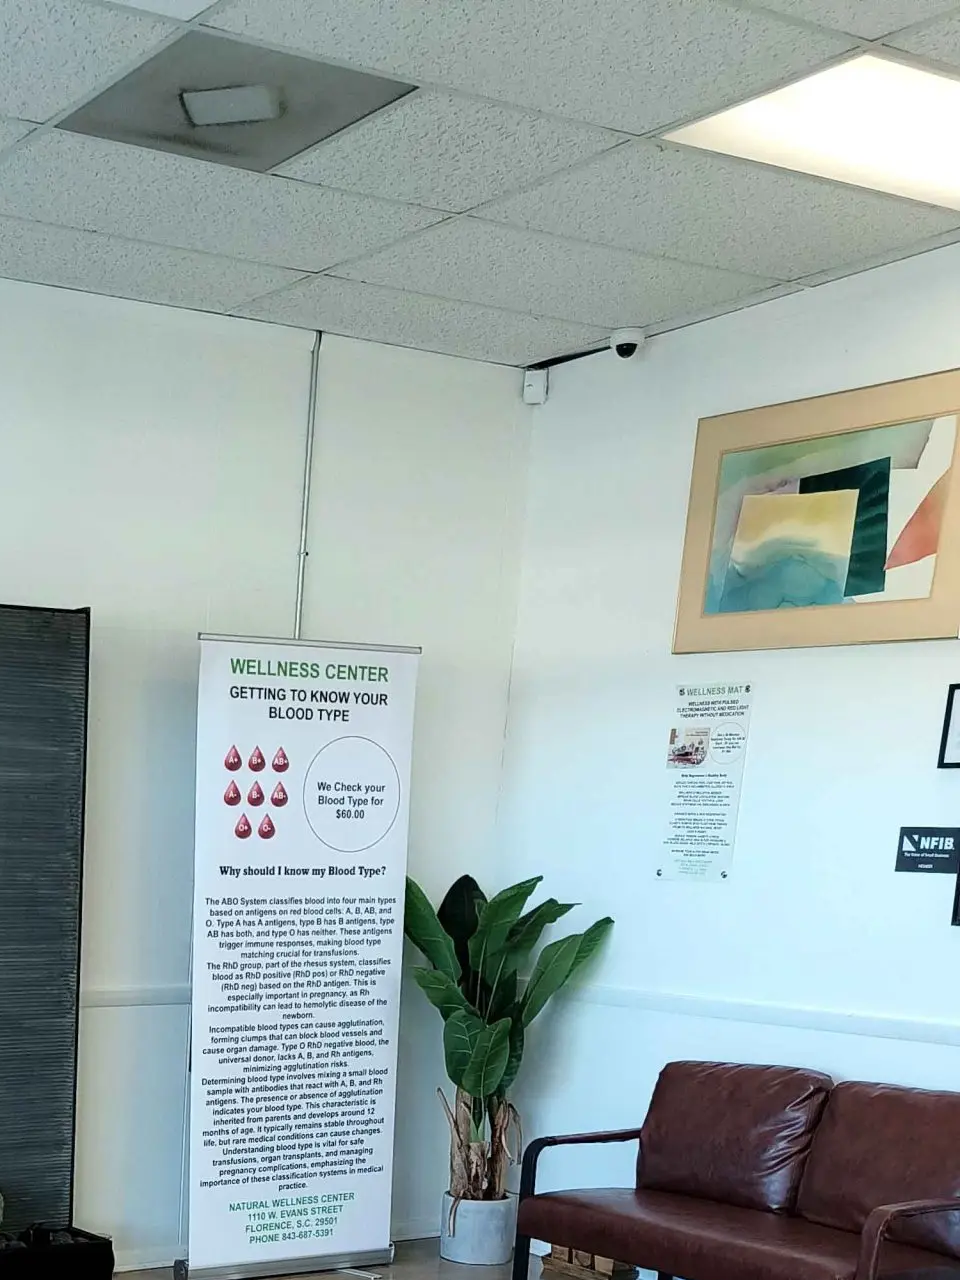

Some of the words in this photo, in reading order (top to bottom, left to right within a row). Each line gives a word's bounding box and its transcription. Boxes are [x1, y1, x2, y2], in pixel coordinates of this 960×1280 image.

[230, 658, 319, 679] WELLNESS
[325, 663, 388, 682] CENTER
[230, 686, 286, 701] GETTING
[291, 689, 306, 702] TO
[310, 690, 350, 704] KNOW
[353, 692, 387, 706] YOUR
[687, 687, 726, 696] WELLNESS
[728, 686, 744, 695] MAT
[269, 707, 313, 720] BLOOD
[319, 709, 349, 722] TYPE
[229, 756, 237, 764] A+
[317, 781, 331, 792] We
[333, 781, 362, 792] Check
[364, 783, 384, 795] your
[317, 794, 345, 805] Blood
[348, 794, 368, 809] Type
[370, 795, 383, 806] for
[336, 808, 364, 818] $60.00
[920, 837, 954, 850] NFIB
[219, 865, 240, 878] Why
[243, 865, 275, 875] should
[277, 865, 281, 875] I
[284, 865, 309, 875] know
[311, 867, 325, 878] my
[328, 865, 355, 875] Blood
[358, 865, 385, 878] Type?
[221, 897, 238, 905] ABO
[240, 897, 267, 906] System
[377, 896, 396, 905] types
[218, 940, 243, 949] trigger
[275, 940, 315, 948] responses,
[316, 938, 342, 948] making
[365, 938, 381, 947] type
[240, 950, 274, 959] matching
[313, 948, 359, 956] transfusions.
[222, 961, 238, 969] RhD
[239, 962, 263, 970] group,
[265, 960, 280, 969] part
[303, 959, 327, 967] rhesus
[329, 959, 357, 968] system,
[227, 992, 263, 1002] especially
[264, 991, 299, 1001] important
[309, 991, 347, 1000] pregnancy,
[207, 1003, 261, 1013] incompatibility
[303, 1000, 337, 1010] hemolytic
[338, 999, 366, 1007] disease
[376, 998, 387, 1006] the
[282, 1011, 315, 1019] newborn.
[208, 1023, 255, 1034] Incompatible
[279, 1022, 299, 1031] types
[337, 1018, 384, 1029] agglutination,
[210, 1034, 239, 1044] forming
[240, 1033, 267, 1043] clumps
[298, 1031, 318, 1039] block
[319, 1030, 340, 1038] blood
[341, 1029, 367, 1037] vessels
[369, 1028, 382, 1036] and
[242, 1063, 282, 1074] minimizing
[283, 1061, 329, 1072] agglutination
[330, 1060, 349, 1068] risks.
[201, 1075, 246, 1086] Determining
[247, 1074, 268, 1082] blood
[269, 1073, 285, 1083] type
[286, 1071, 315, 1080] involves
[317, 1070, 341, 1080] mixing
[348, 1069, 367, 1077] small
[213, 1116, 245, 1124] inherited
[246, 1114, 263, 1122] from
[264, 1113, 291, 1123] parents
[292, 1112, 306, 1120] and
[307, 1110, 339, 1120] develops
[340, 1108, 365, 1117] around
[222, 1144, 274, 1156] Understanding
[275, 1142, 296, 1151] blood
[297, 1141, 313, 1151] type
[349, 1137, 364, 1146] safe
[212, 1155, 259, 1166] transfusions,
[260, 1155, 281, 1163] organ
[282, 1150, 323, 1162] transplants,
[325, 1149, 338, 1157] and
[339, 1147, 373, 1158] managing
[218, 1166, 256, 1176] pregnancy
[257, 1161, 309, 1173] complications,
[310, 1157, 353, 1169] emphasizing
[199, 1176, 240, 1188] importance
[241, 1175, 249, 1183] of
[250, 1174, 270, 1182] these
[271, 1170, 317, 1181] classification
[318, 1168, 347, 1179] systems
[348, 1167, 356, 1175] in
[356, 1165, 383, 1174] medical
[278, 1181, 308, 1191] practice.
[229, 1200, 270, 1211] NATURAL
[271, 1196, 318, 1207] WELLNESS
[320, 1193, 354, 1203] CENTER
[248, 1212, 266, 1221] 1110
[267, 1210, 279, 1219] W.
[280, 1208, 308, 1218] EVANS
[310, 1205, 342, 1216] STREET
[245, 1221, 295, 1234] FLORENCE,
[296, 1219, 313, 1228] S.C.
[314, 1217, 337, 1227] 29501
[249, 1233, 280, 1243] PHONE
[281, 1229, 333, 1241] 843-687-5391
